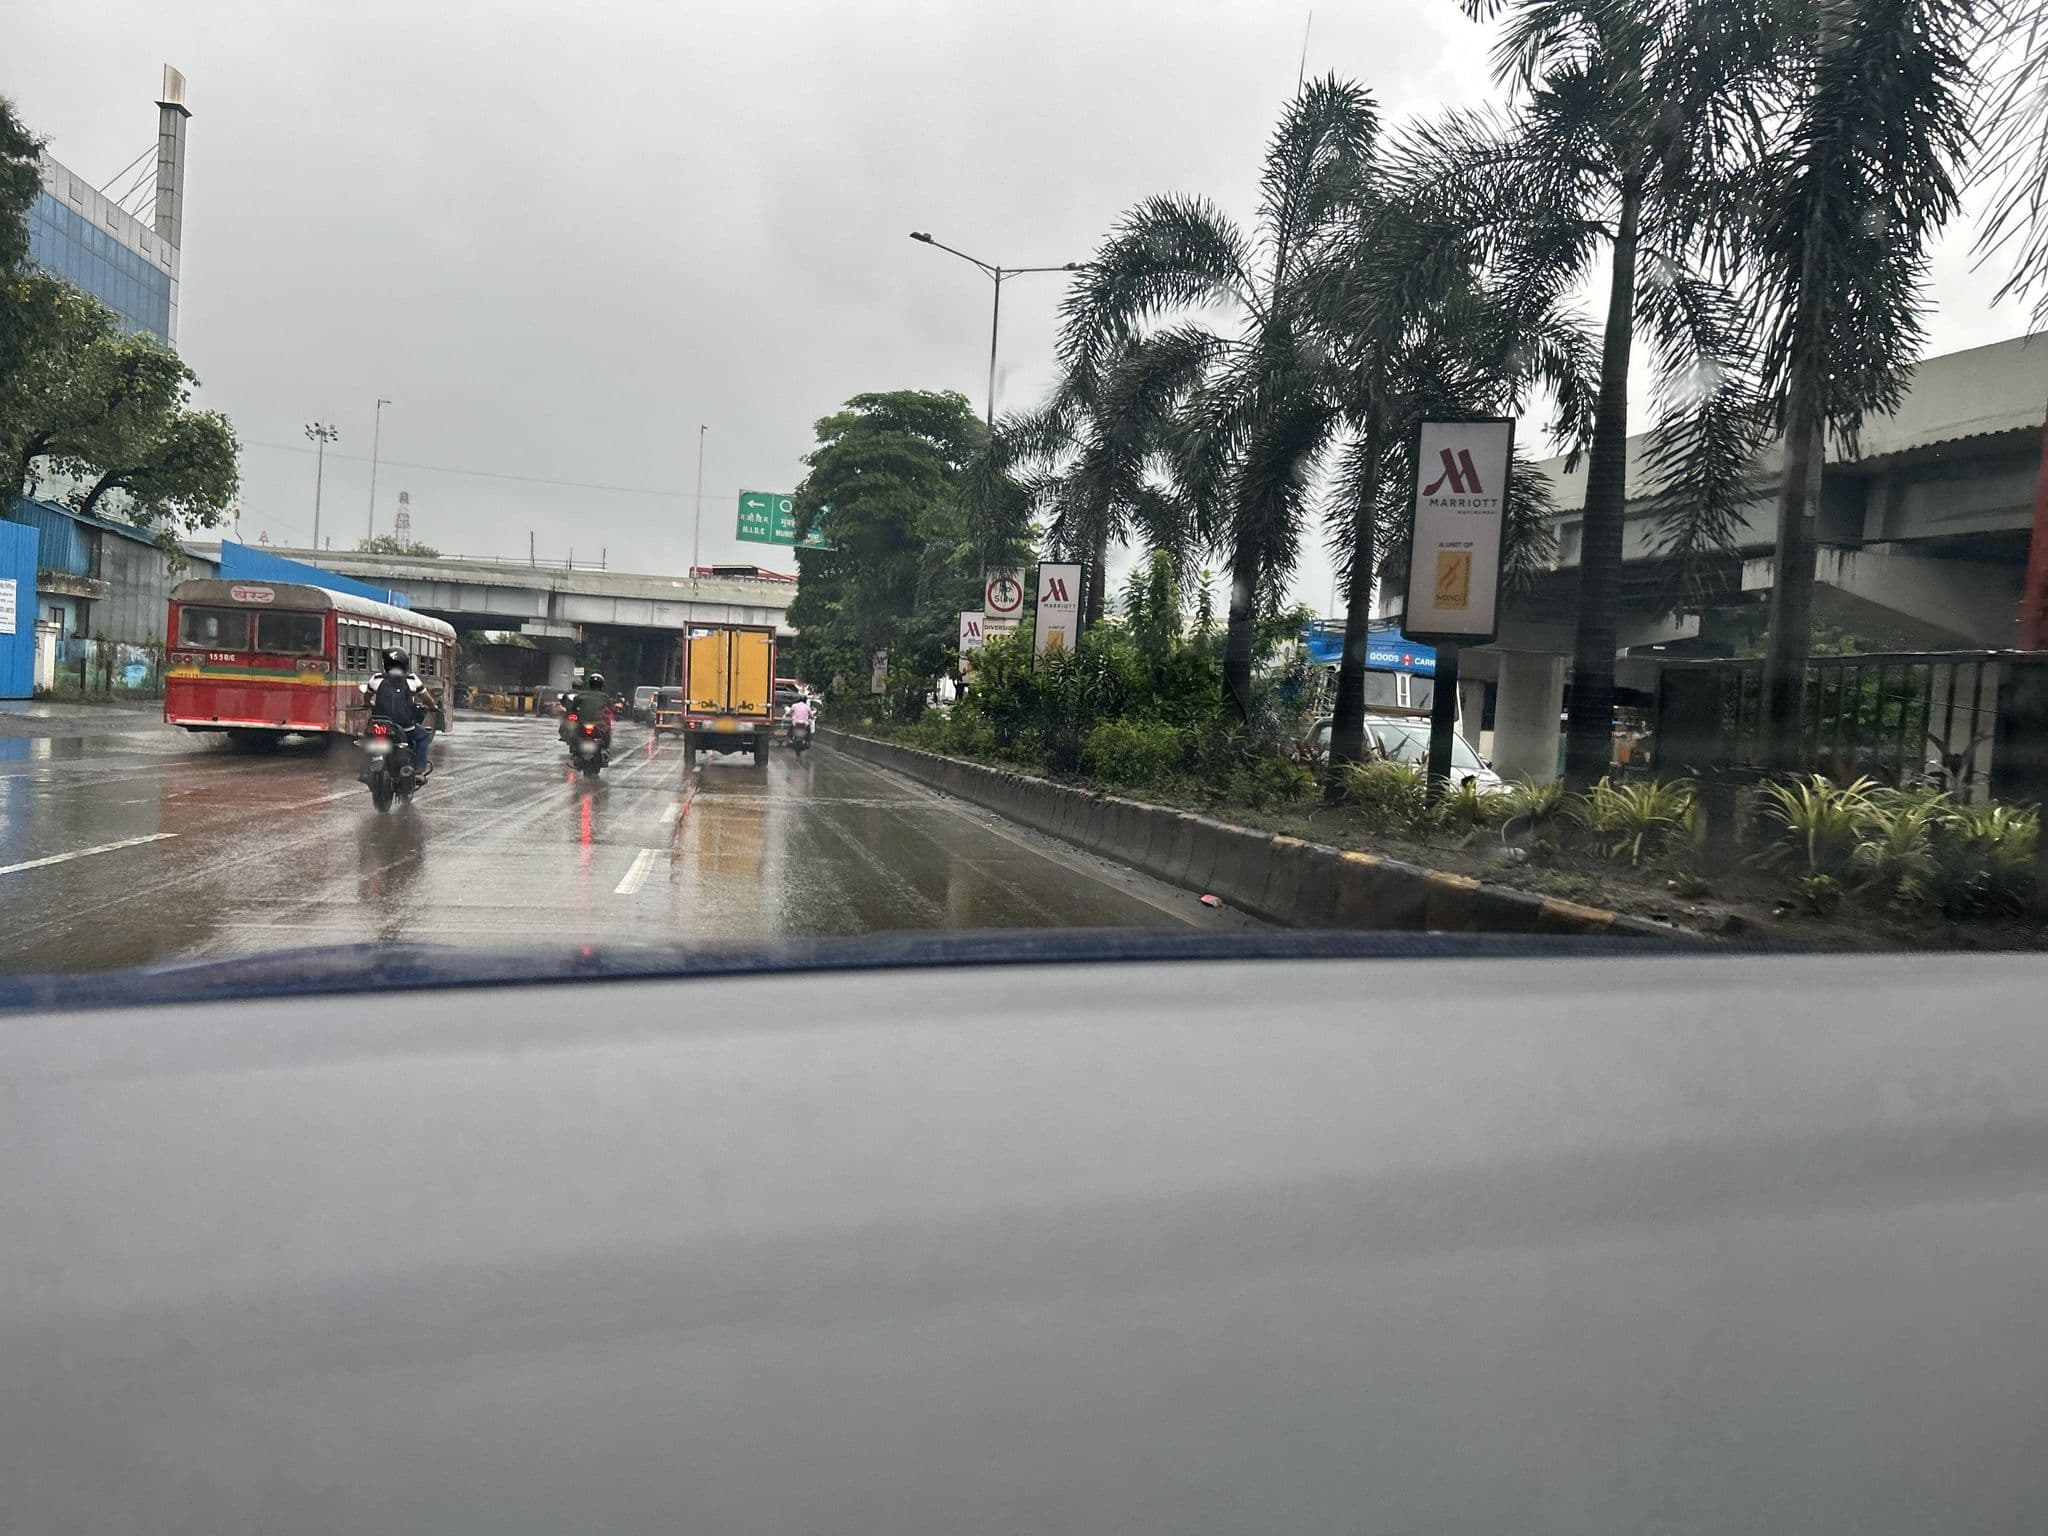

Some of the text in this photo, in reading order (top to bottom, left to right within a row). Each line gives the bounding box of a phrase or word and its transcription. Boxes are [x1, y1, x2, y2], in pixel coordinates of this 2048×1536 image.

[1429, 498, 1498, 508] MARRIOTT
[232, 586, 273, 602] बेस्ट
[1369, 652, 1399, 662] GOODS
